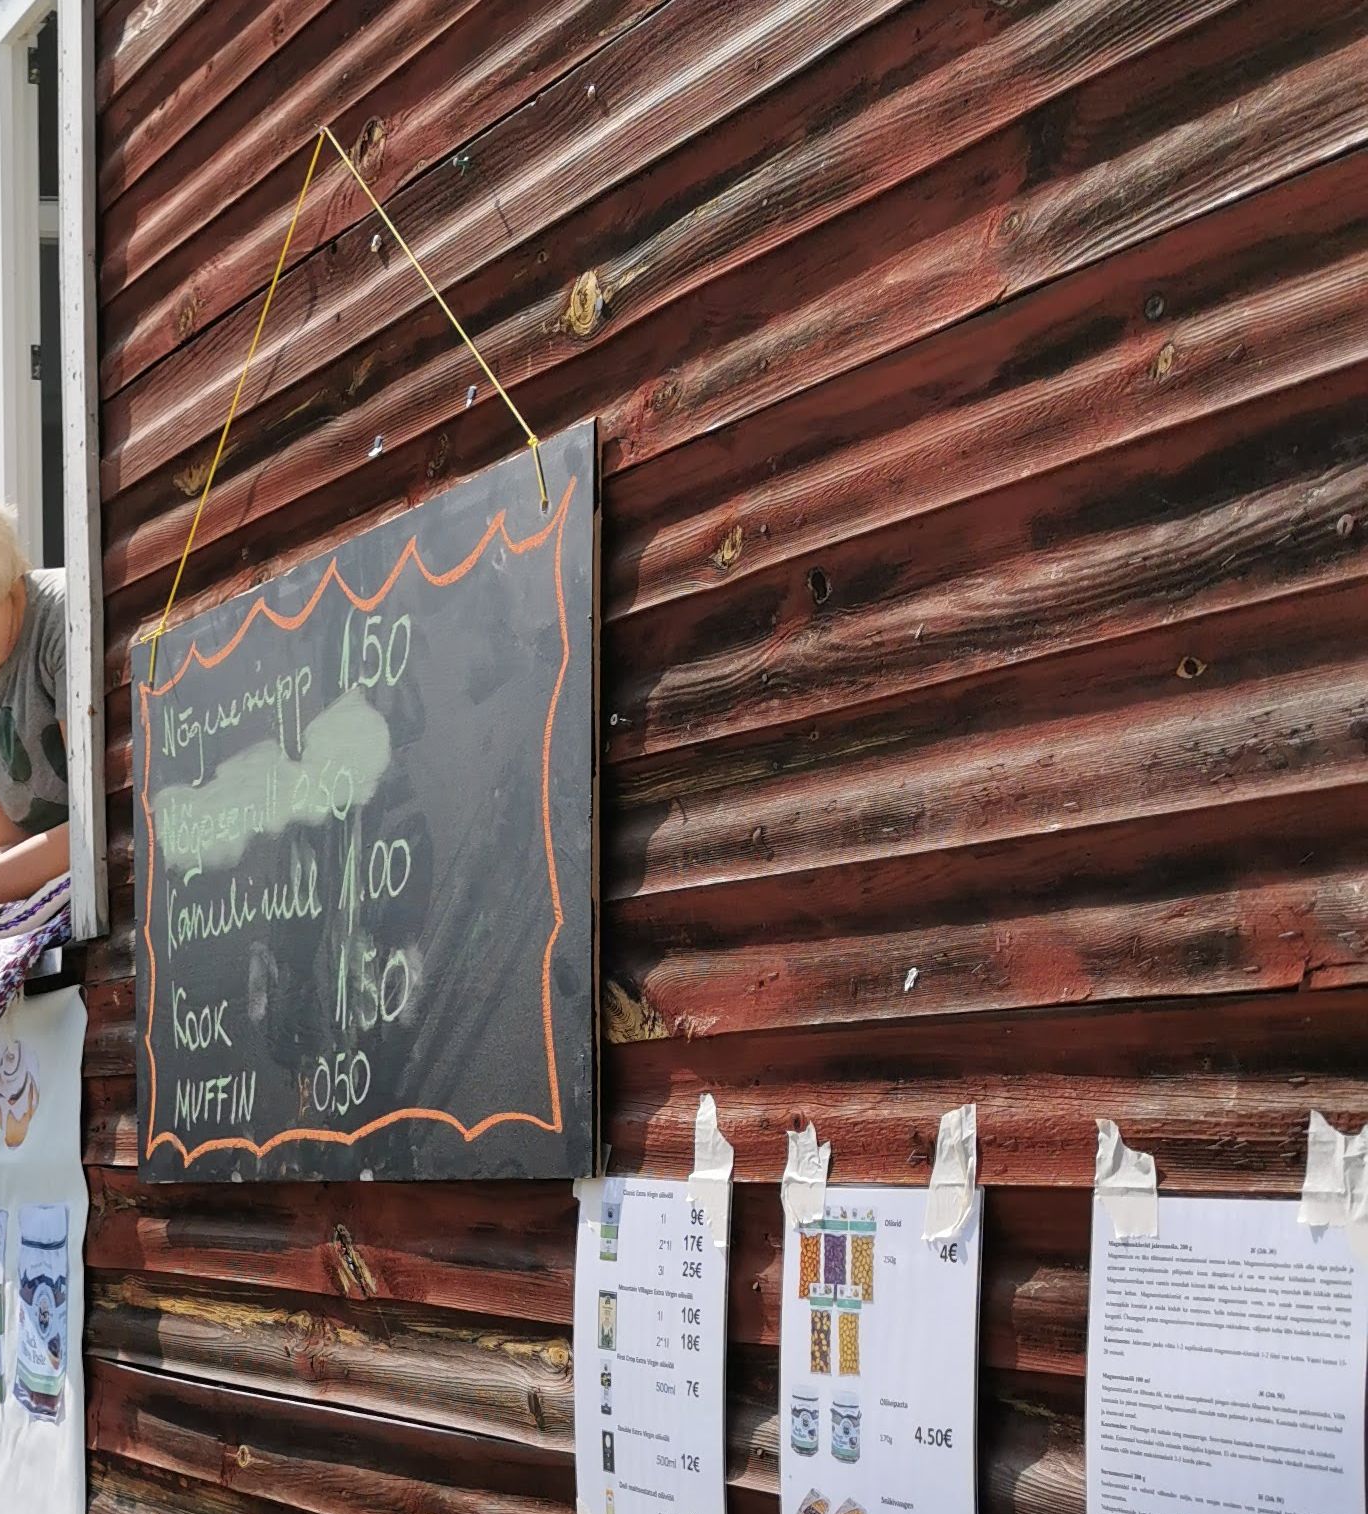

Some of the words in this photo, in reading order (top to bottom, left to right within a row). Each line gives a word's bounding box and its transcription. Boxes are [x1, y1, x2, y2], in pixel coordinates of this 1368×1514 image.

[174, 1070, 256, 1131] MUFFIN
[690, 1208, 704, 1226] 9€
[683, 1234, 703, 1253] 17€
[940, 1242, 958, 1263] 4€
[682, 1261, 702, 1279] 25€
[681, 1307, 701, 1325] 10€
[680, 1333, 701, 1352] 18€
[655, 1381, 676, 1396] 500ml
[686, 1379, 700, 1398] 7€
[914, 1425, 953, 1449] 4.50€
[655, 1454, 677, 1470] 500ml
[681, 1453, 701, 1473] 12€
